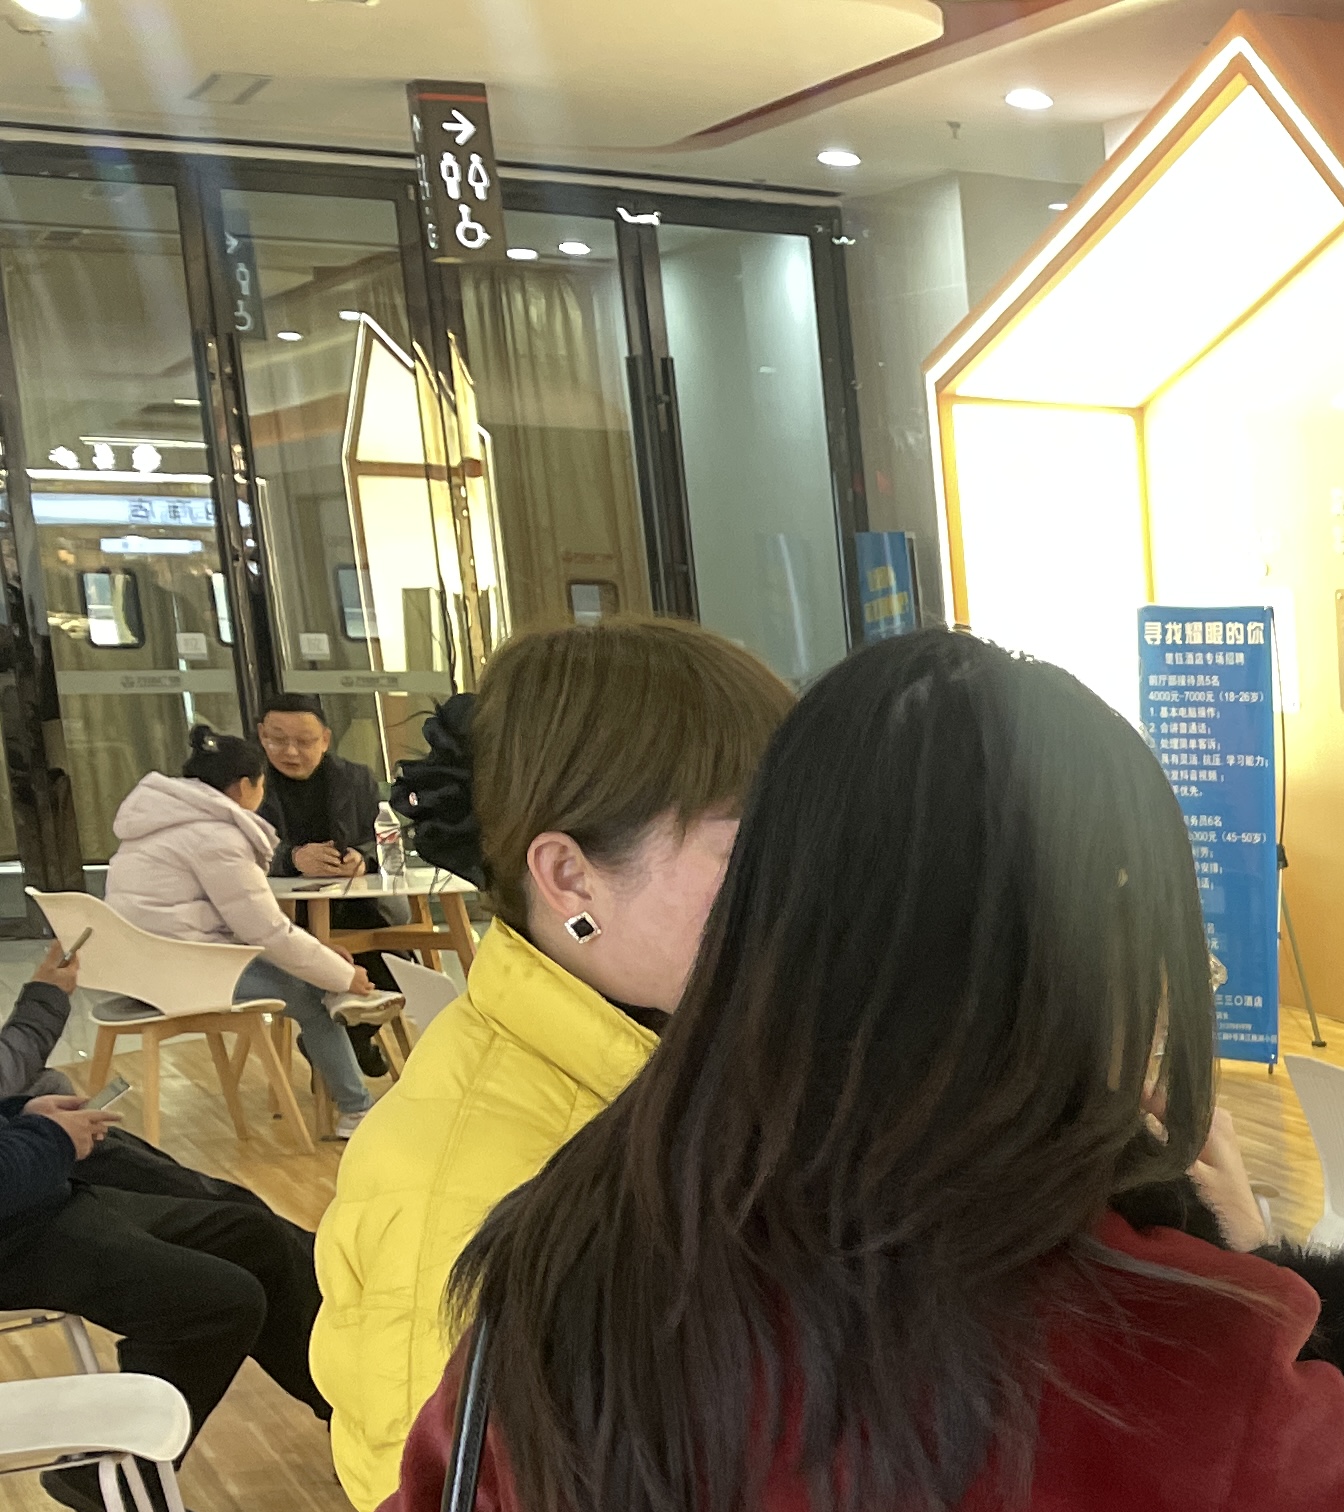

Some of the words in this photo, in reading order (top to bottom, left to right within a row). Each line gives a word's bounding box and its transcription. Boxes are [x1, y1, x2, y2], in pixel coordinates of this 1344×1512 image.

[1144, 621, 1265, 645] 寻找耀眼的你
